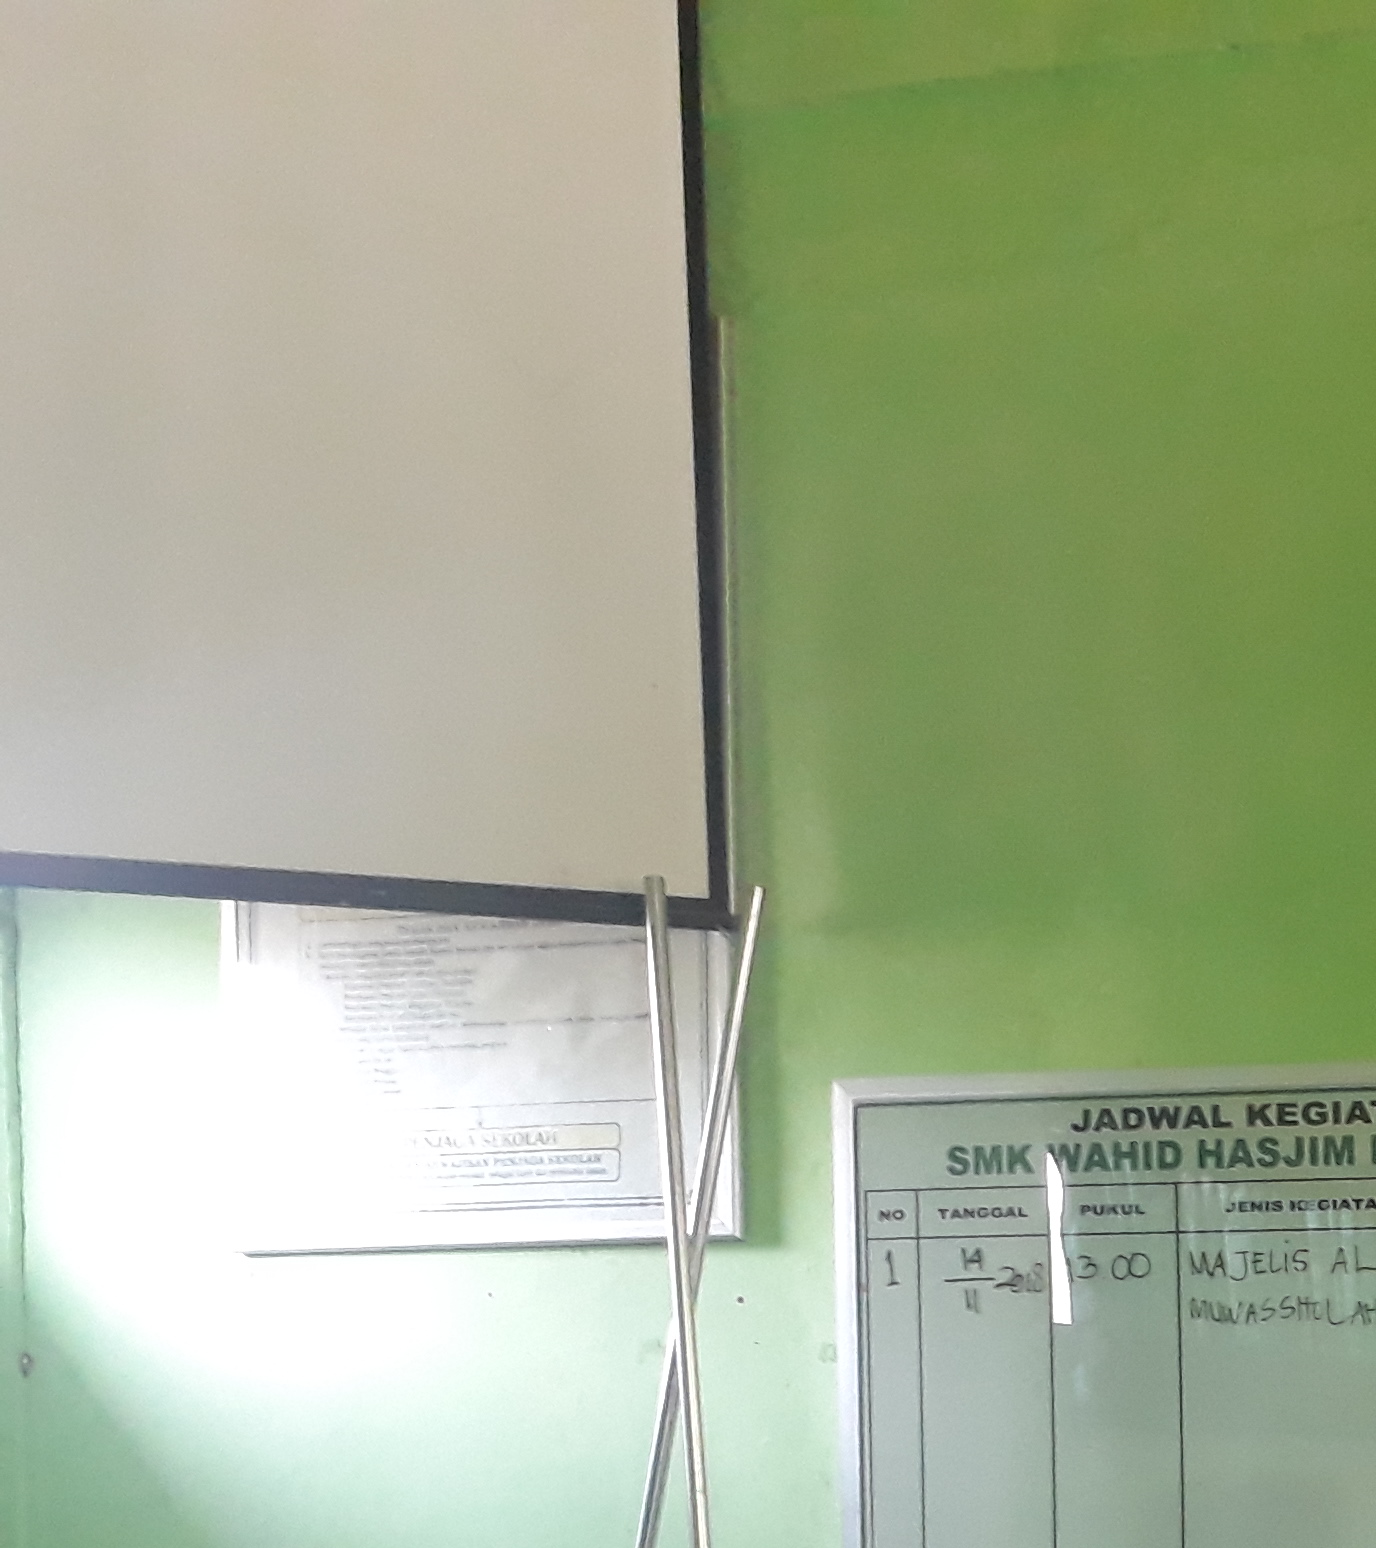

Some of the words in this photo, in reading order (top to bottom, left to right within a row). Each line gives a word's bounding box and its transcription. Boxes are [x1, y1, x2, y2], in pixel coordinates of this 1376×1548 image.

[1070, 1103, 1234, 1133] JADWAL
[945, 1144, 1035, 1176] SMK
[1044, 1140, 1183, 1174] WAHID
[1198, 1134, 1356, 1170] HASJIM
[937, 1206, 1029, 1220] TANGGAL
[1079, 1203, 1145, 1216] PUKUL
[1224, 1199, 1285, 1213] JENIS
[877, 1208, 906, 1221] NO
